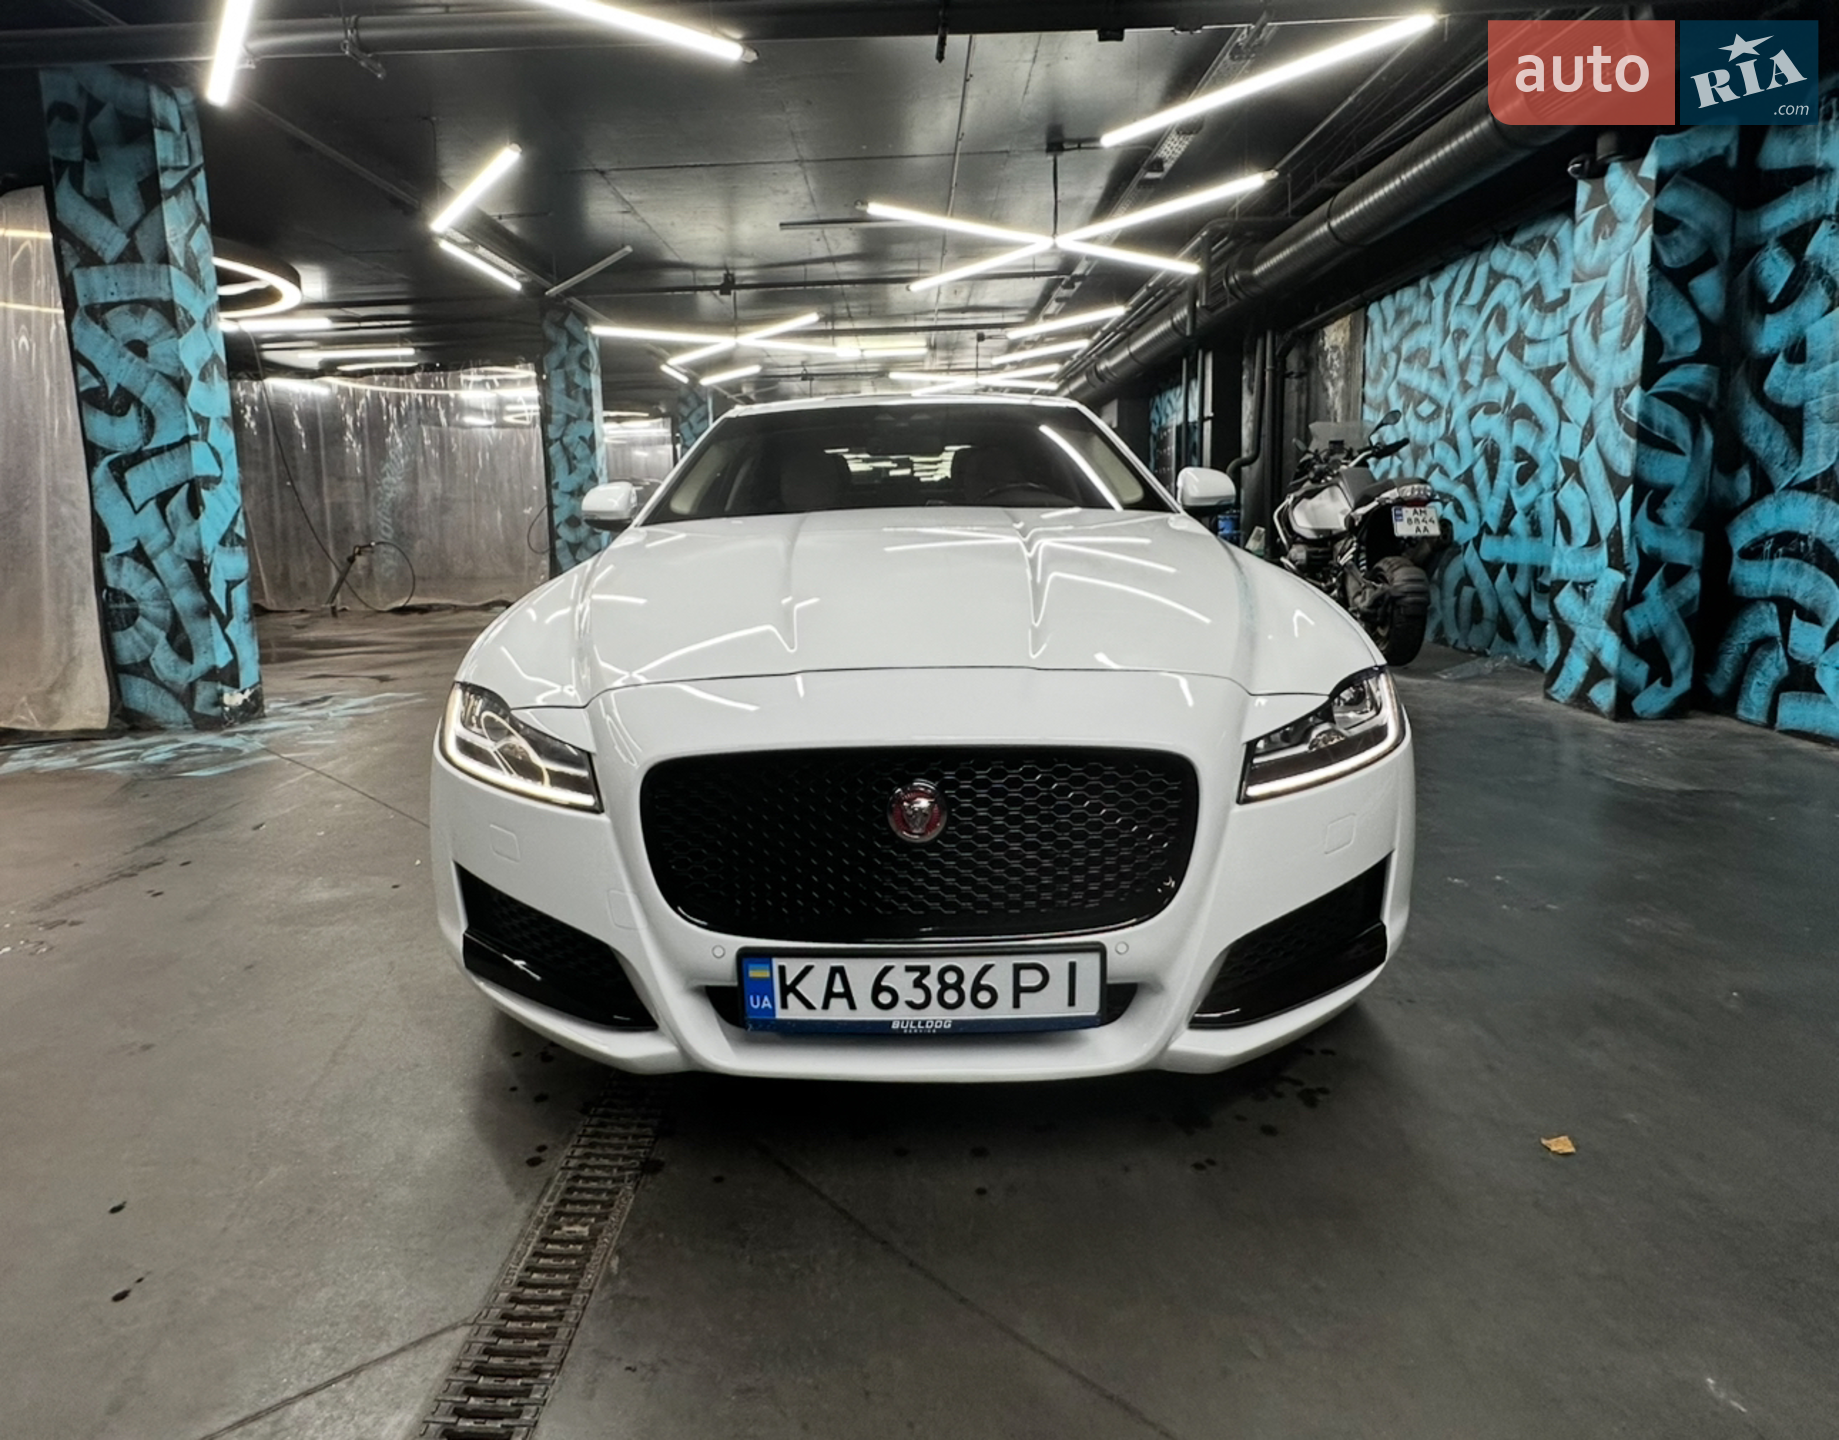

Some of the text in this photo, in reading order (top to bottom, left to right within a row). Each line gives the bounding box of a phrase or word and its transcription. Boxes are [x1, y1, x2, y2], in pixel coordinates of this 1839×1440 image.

[777, 961, 1077, 1010] KA 6386 PI
[749, 995, 773, 1009] UA
[891, 1020, 953, 1029] BULLDOG
